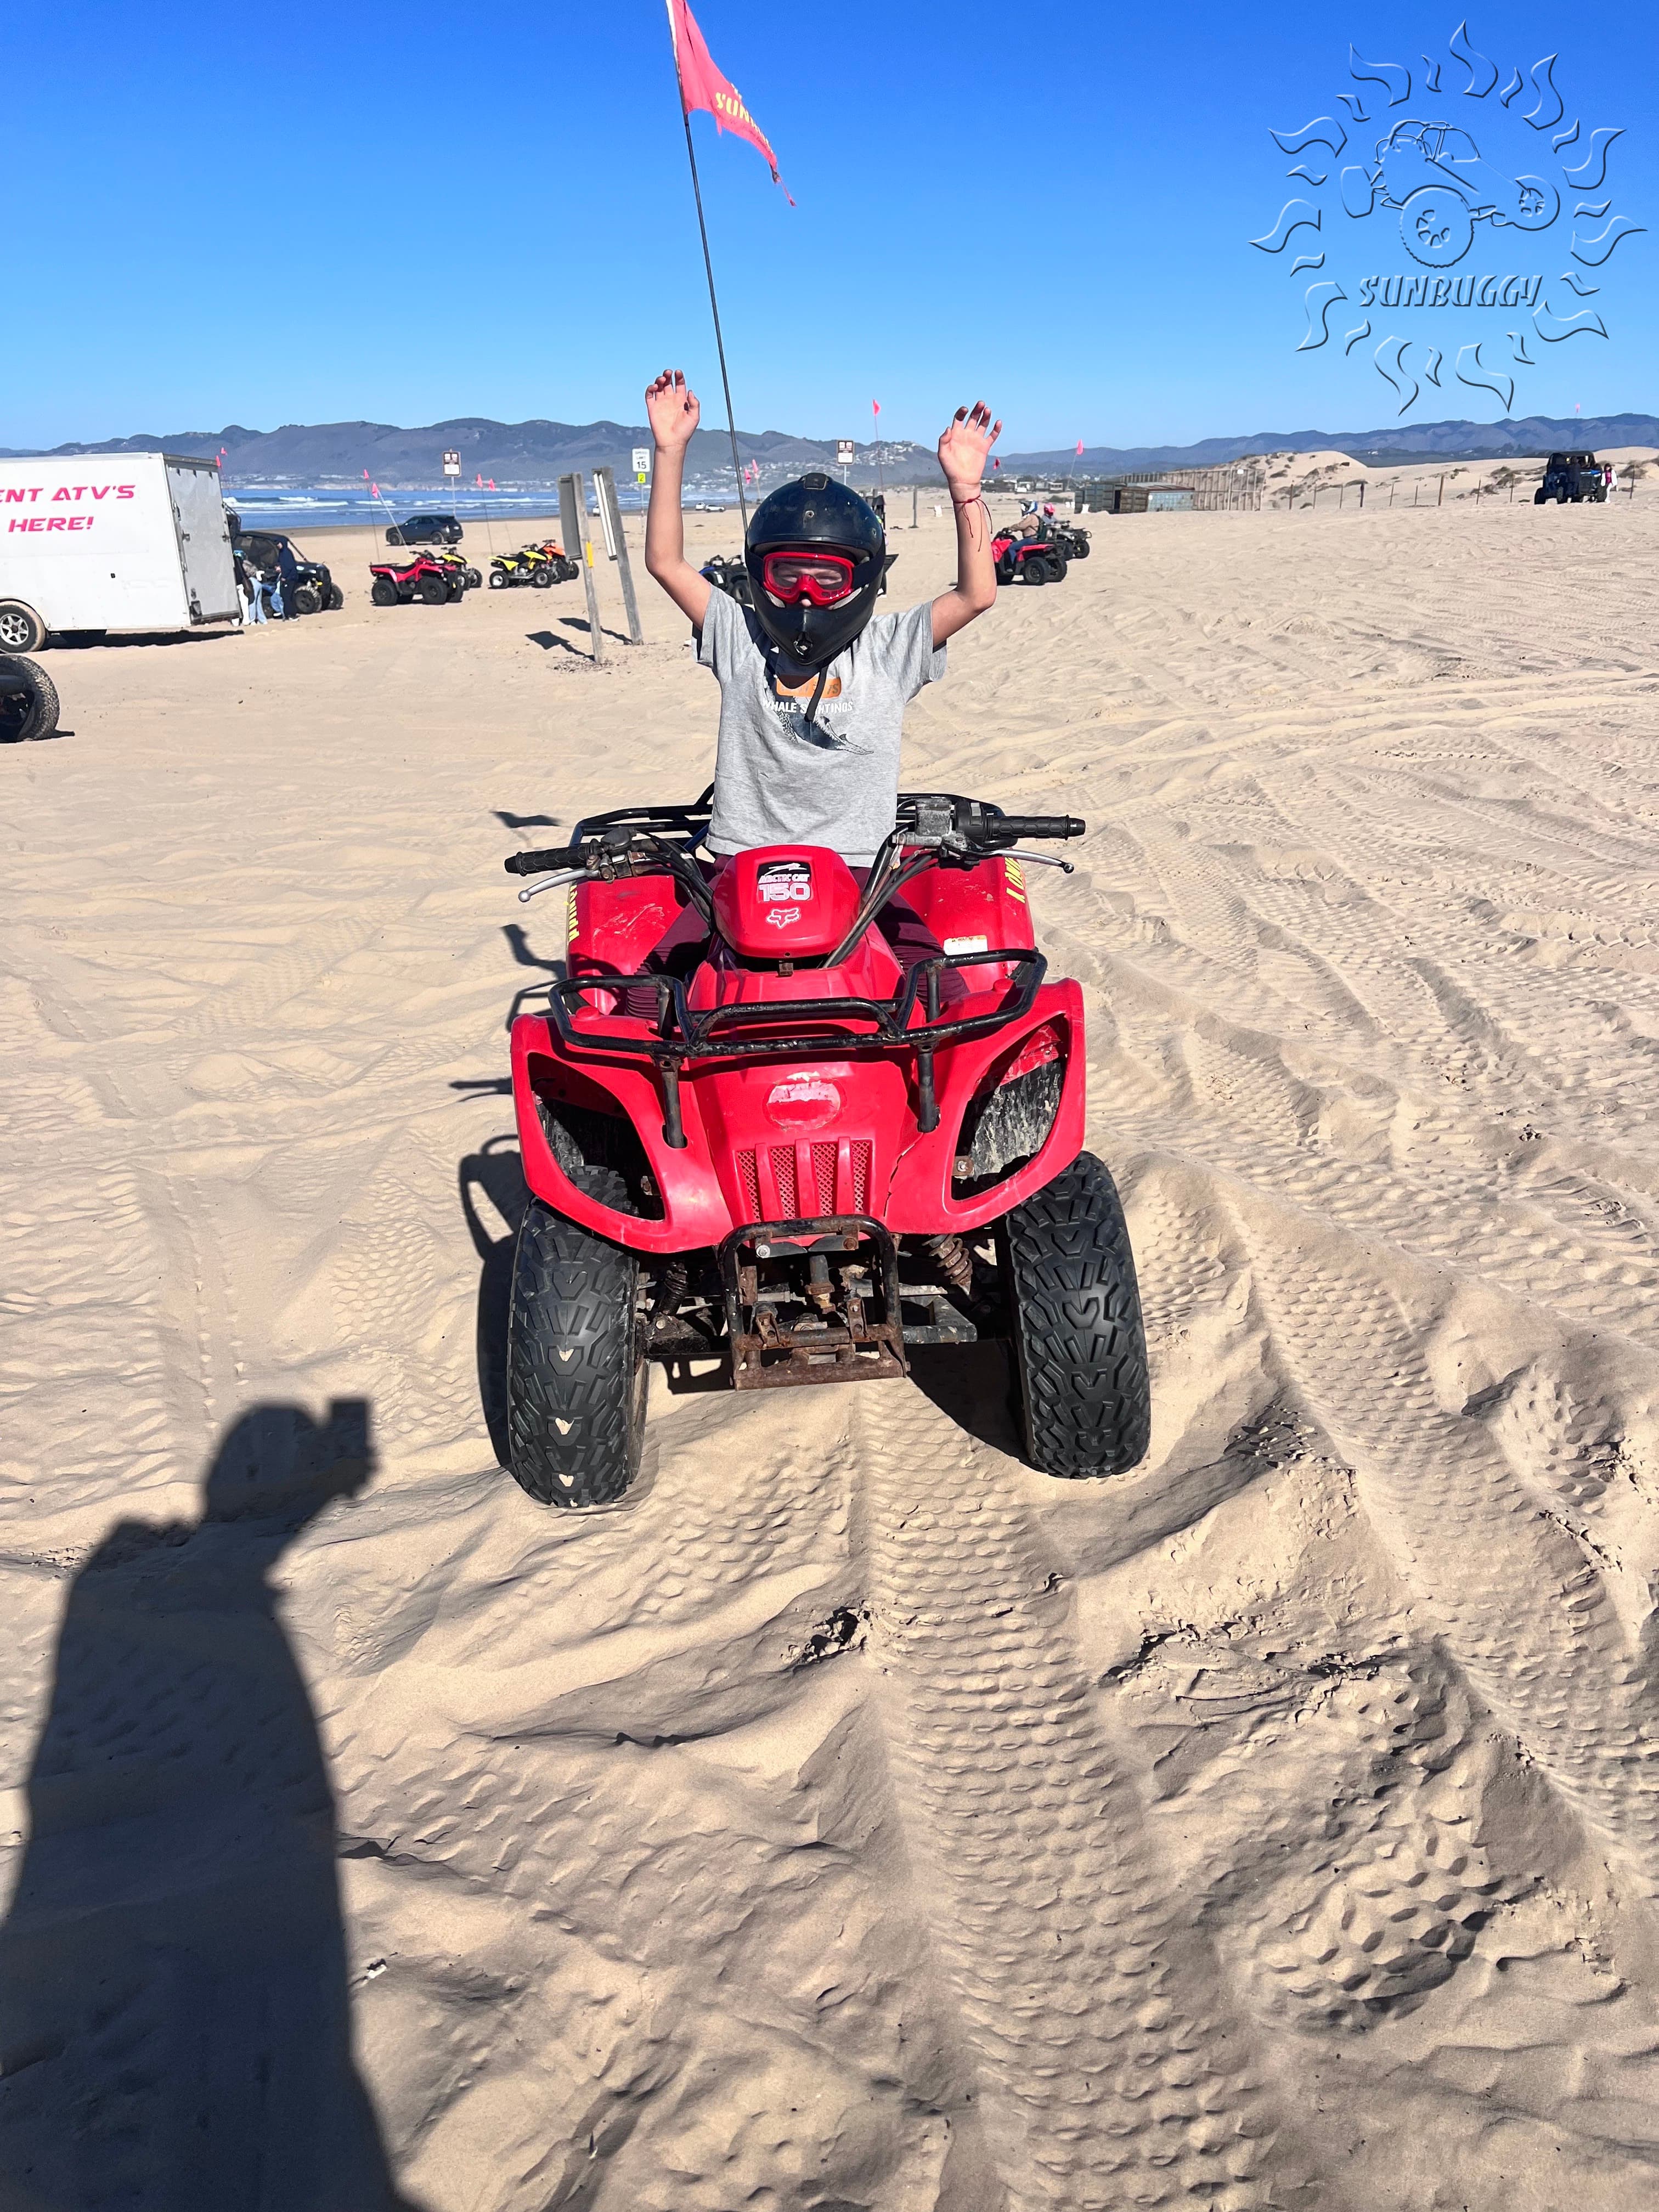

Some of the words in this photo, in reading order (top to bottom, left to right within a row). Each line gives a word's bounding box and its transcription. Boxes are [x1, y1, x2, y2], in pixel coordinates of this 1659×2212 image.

[636, 461, 647, 469] 15
[0, 488, 44, 503] NT
[51, 485, 136, 501] ATV'S
[8, 516, 94, 532] HERE!
[763, 699, 797, 713] WHALE
[800, 702, 853, 714] SHTINGS
[759, 882, 810, 902] 150
